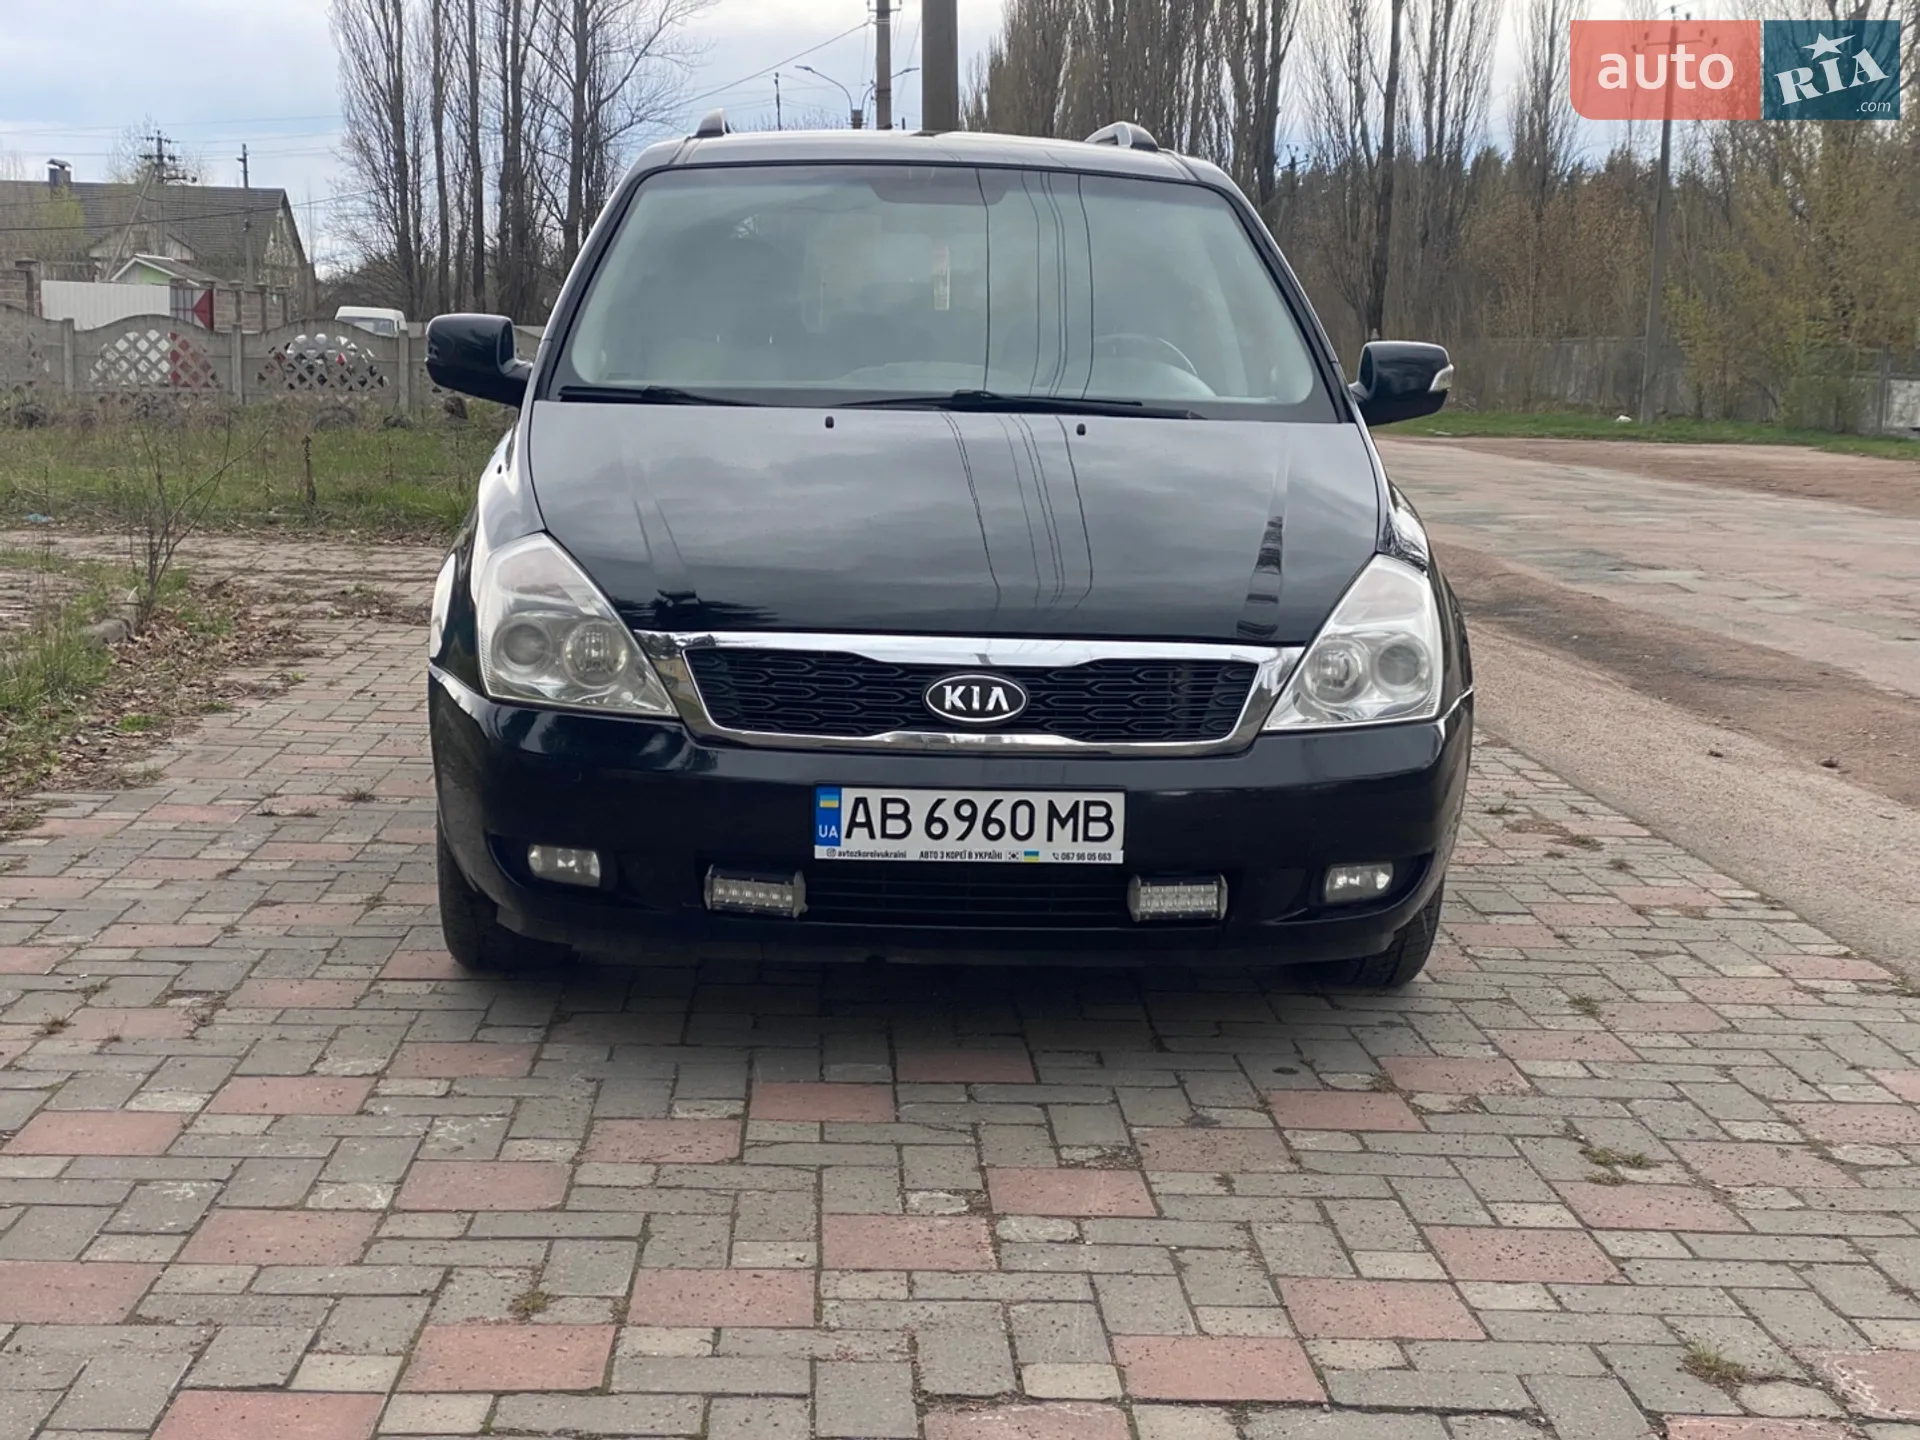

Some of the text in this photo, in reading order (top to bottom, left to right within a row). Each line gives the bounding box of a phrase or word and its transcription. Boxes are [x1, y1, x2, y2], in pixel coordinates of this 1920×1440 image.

[942, 685, 1010, 712] KIA
[845, 796, 1114, 843] AB 6960 MB
[818, 825, 838, 838] UA
[919, 850, 938, 859] АВТО
[945, 849, 967, 860] КОРЕЇ
[974, 849, 1002, 860] УКРАЇНІ
